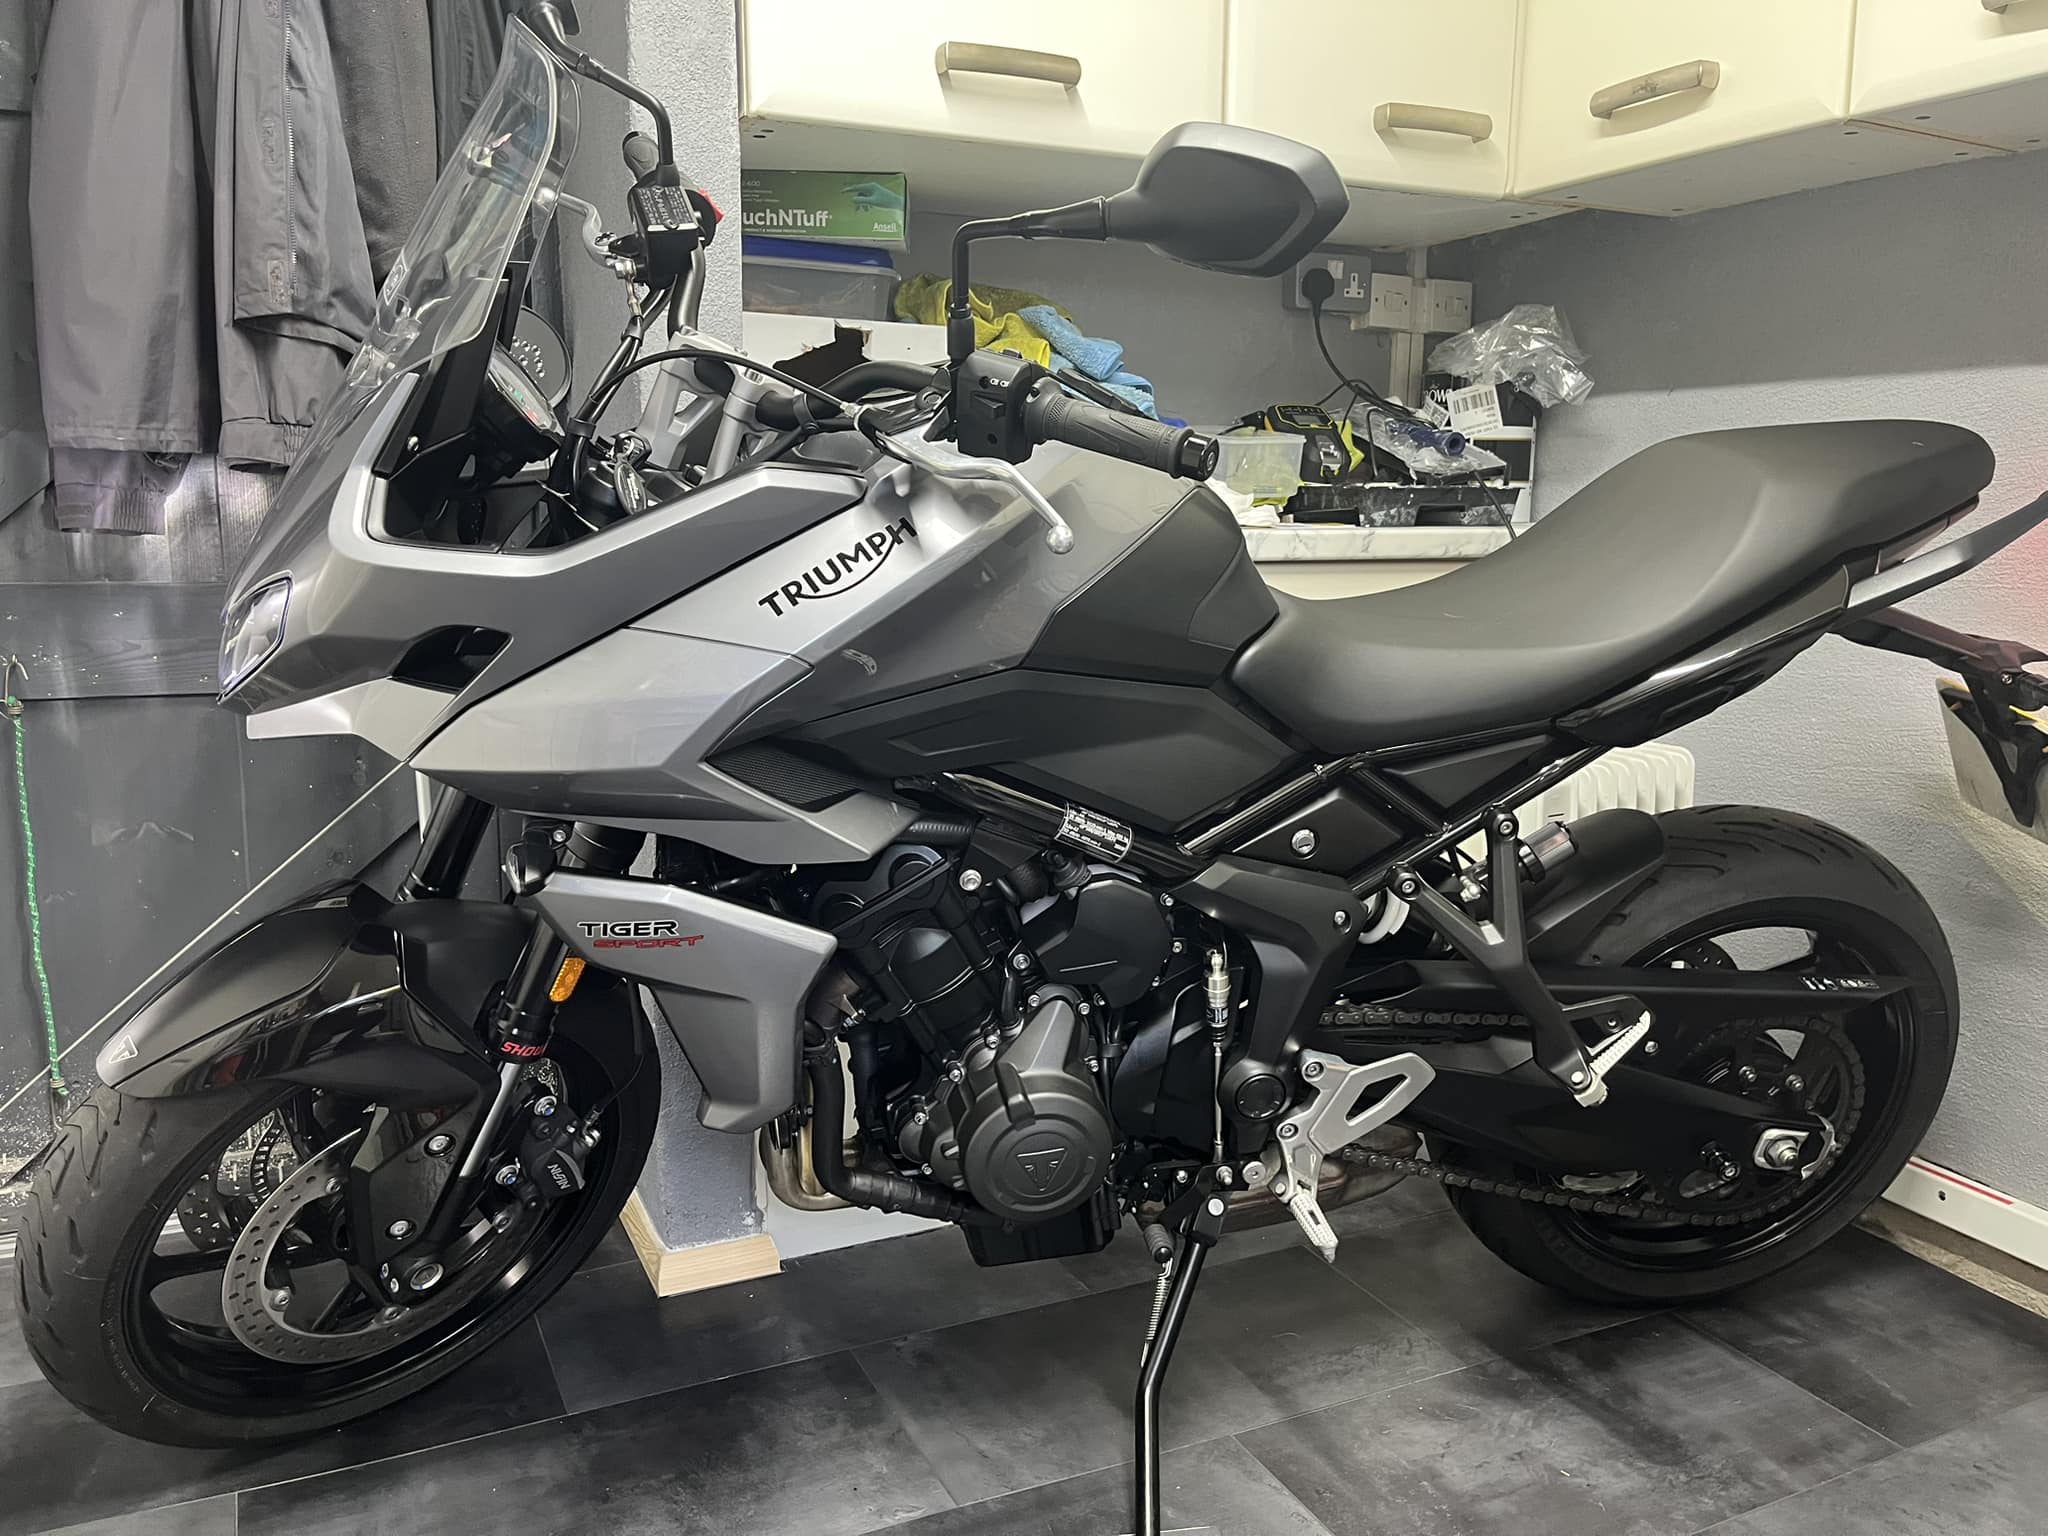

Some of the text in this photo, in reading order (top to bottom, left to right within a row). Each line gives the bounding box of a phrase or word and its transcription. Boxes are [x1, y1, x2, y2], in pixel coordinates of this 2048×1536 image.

[758, 516, 918, 617] TRIUMPH
[577, 919, 679, 937] TIGER
[593, 934, 705, 949] SPORT
